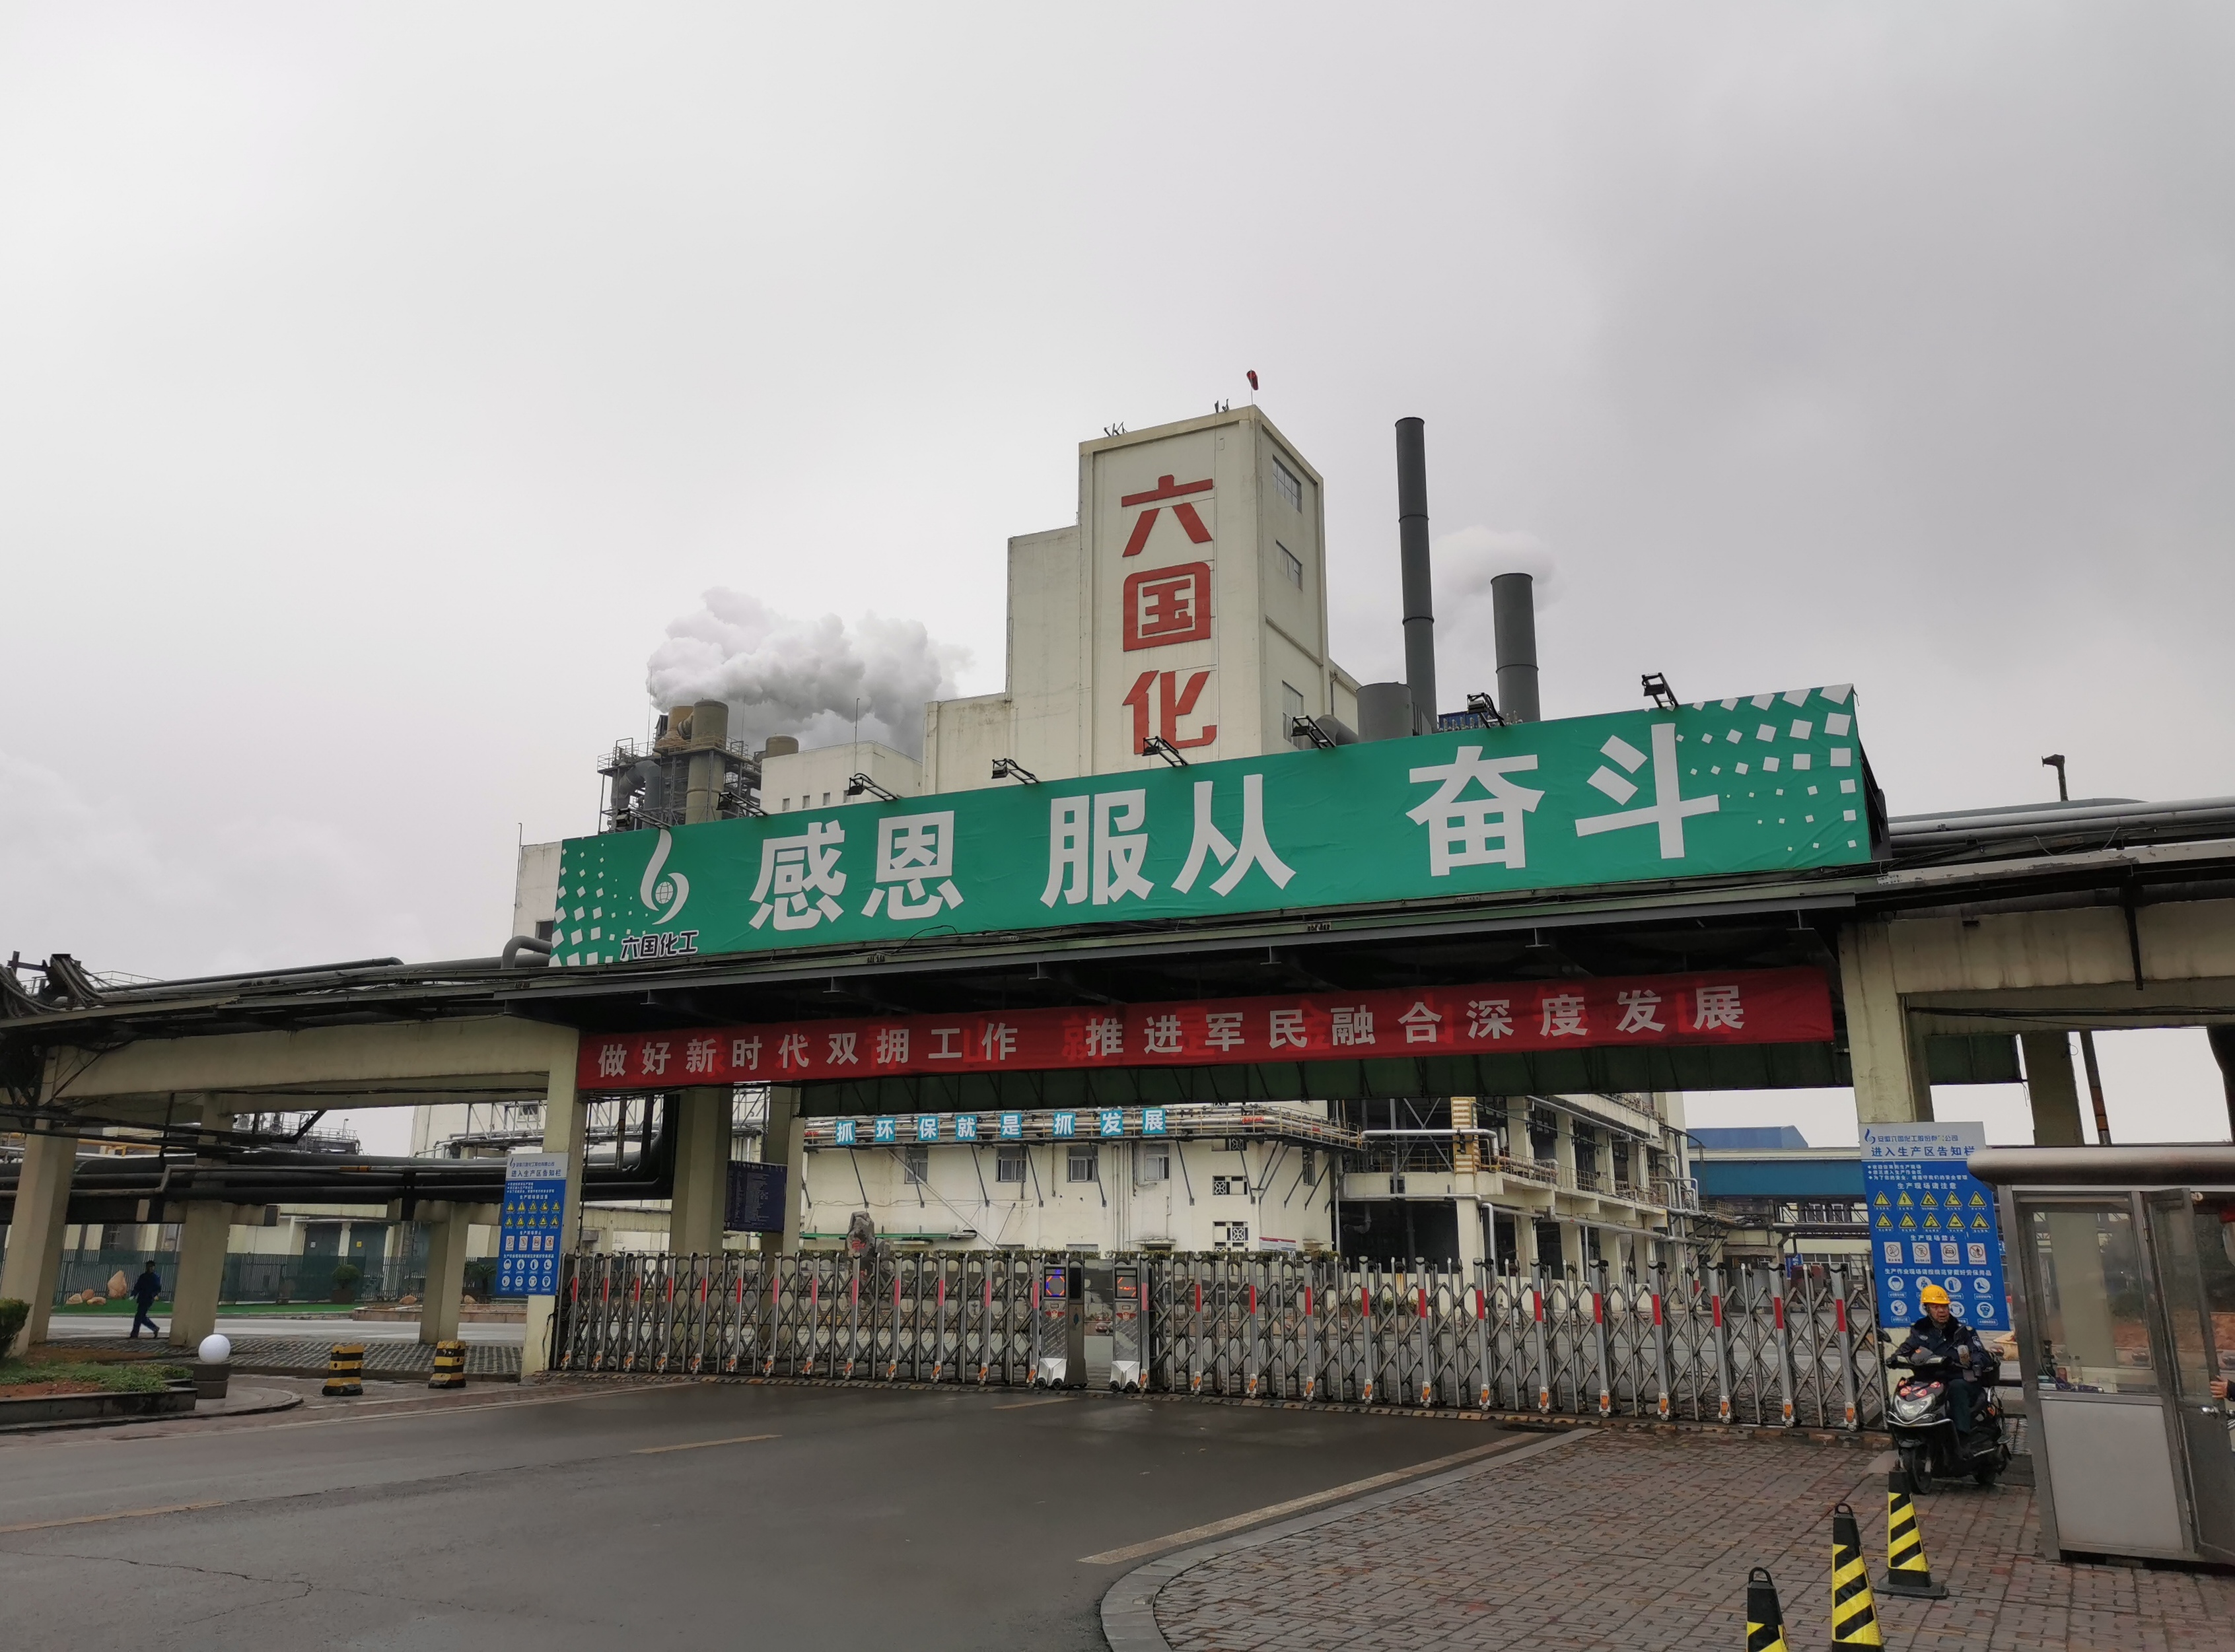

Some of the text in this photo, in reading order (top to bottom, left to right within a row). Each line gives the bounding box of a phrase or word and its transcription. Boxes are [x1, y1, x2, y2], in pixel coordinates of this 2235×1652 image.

[1121, 473, 1218, 755] 六国化
[748, 722, 1720, 931] 感恩 服从 奋斗
[621, 930, 699, 959] 六国化工
[598, 984, 1745, 1078] 做好新时代双拥工作 推进军民融合深度发展
[1871, 1146, 1975, 1157] 进入生产区告知栏
